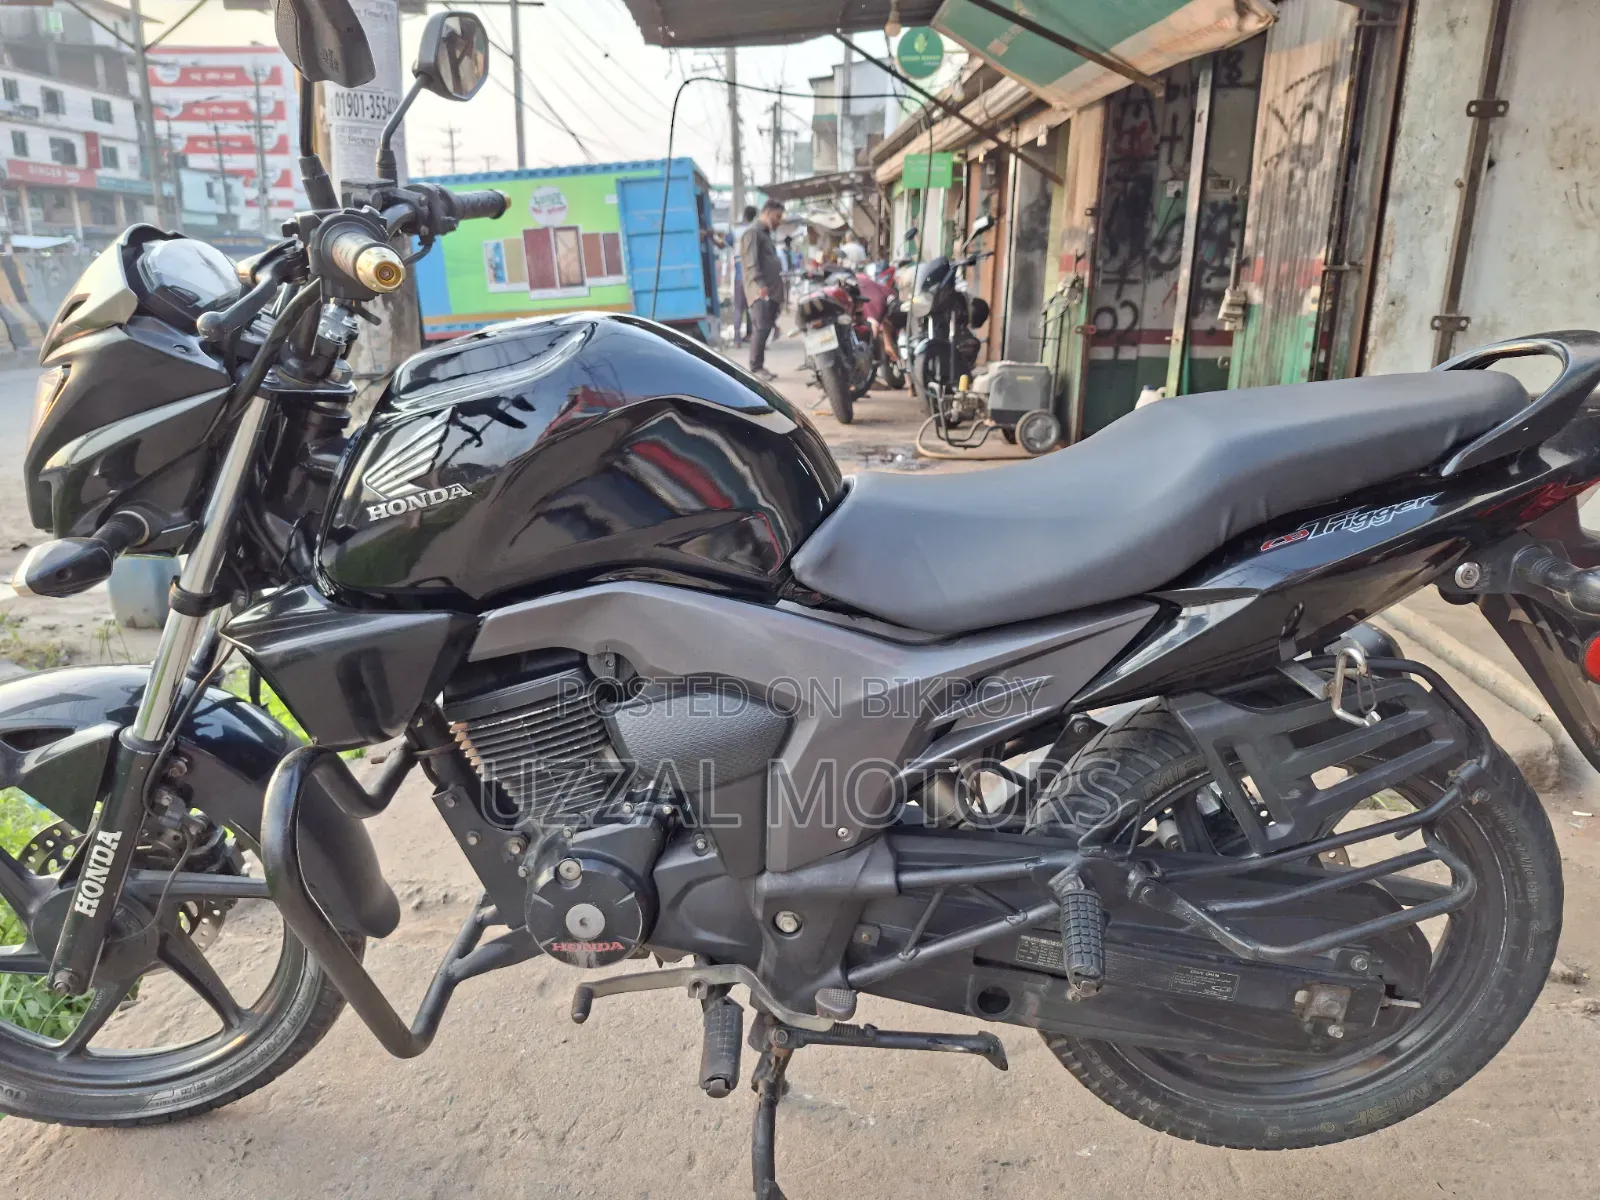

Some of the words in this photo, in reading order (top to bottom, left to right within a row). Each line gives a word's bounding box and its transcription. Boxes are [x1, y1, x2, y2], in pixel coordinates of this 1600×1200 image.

[366, 483, 472, 521] HONDA
[1298, 491, 1446, 540] Trigger
[74, 831, 123, 918] HONDA
[551, 941, 625, 952] HONDA
[1345, 1082, 1435, 1129] MRF
